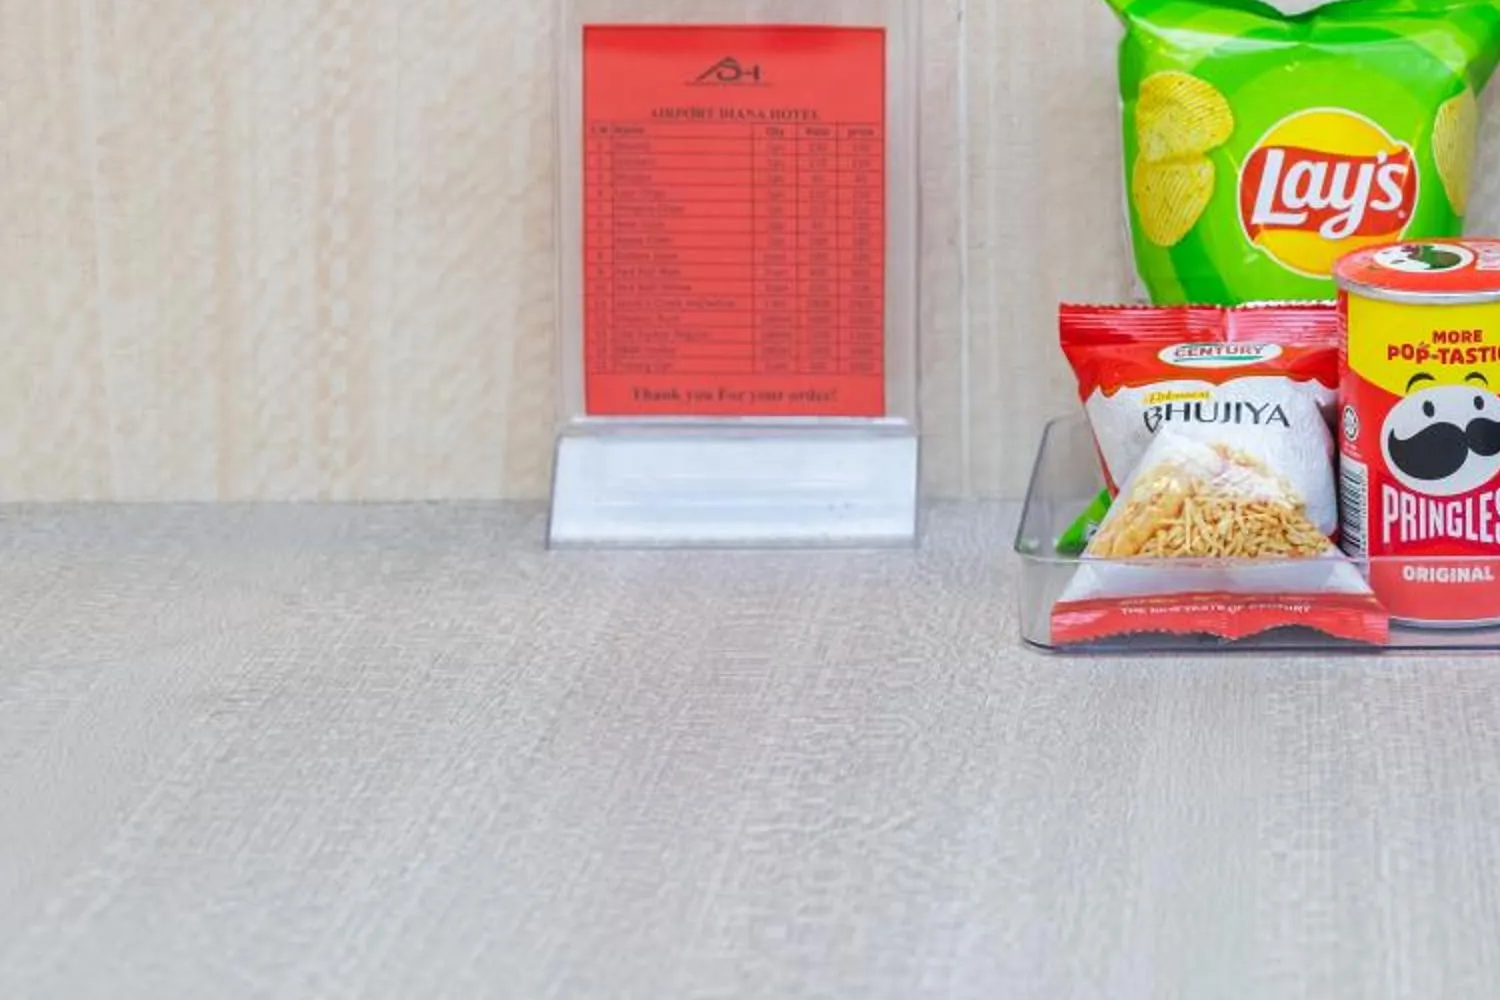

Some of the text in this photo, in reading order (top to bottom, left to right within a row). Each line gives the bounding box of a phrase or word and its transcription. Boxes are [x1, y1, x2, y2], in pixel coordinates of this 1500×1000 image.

[770, 108, 819, 121] HOTEL
[1250, 148, 1408, 241] Lay's
[1432, 330, 1483, 345] MORE
[1174, 345, 1264, 357] CENTURY
[632, 386, 681, 401] Thank
[685, 390, 713, 405] you
[747, 390, 784, 405] your
[1143, 401, 1291, 434] BHUJIYA
[1403, 565, 1495, 583] ORIGINAL
